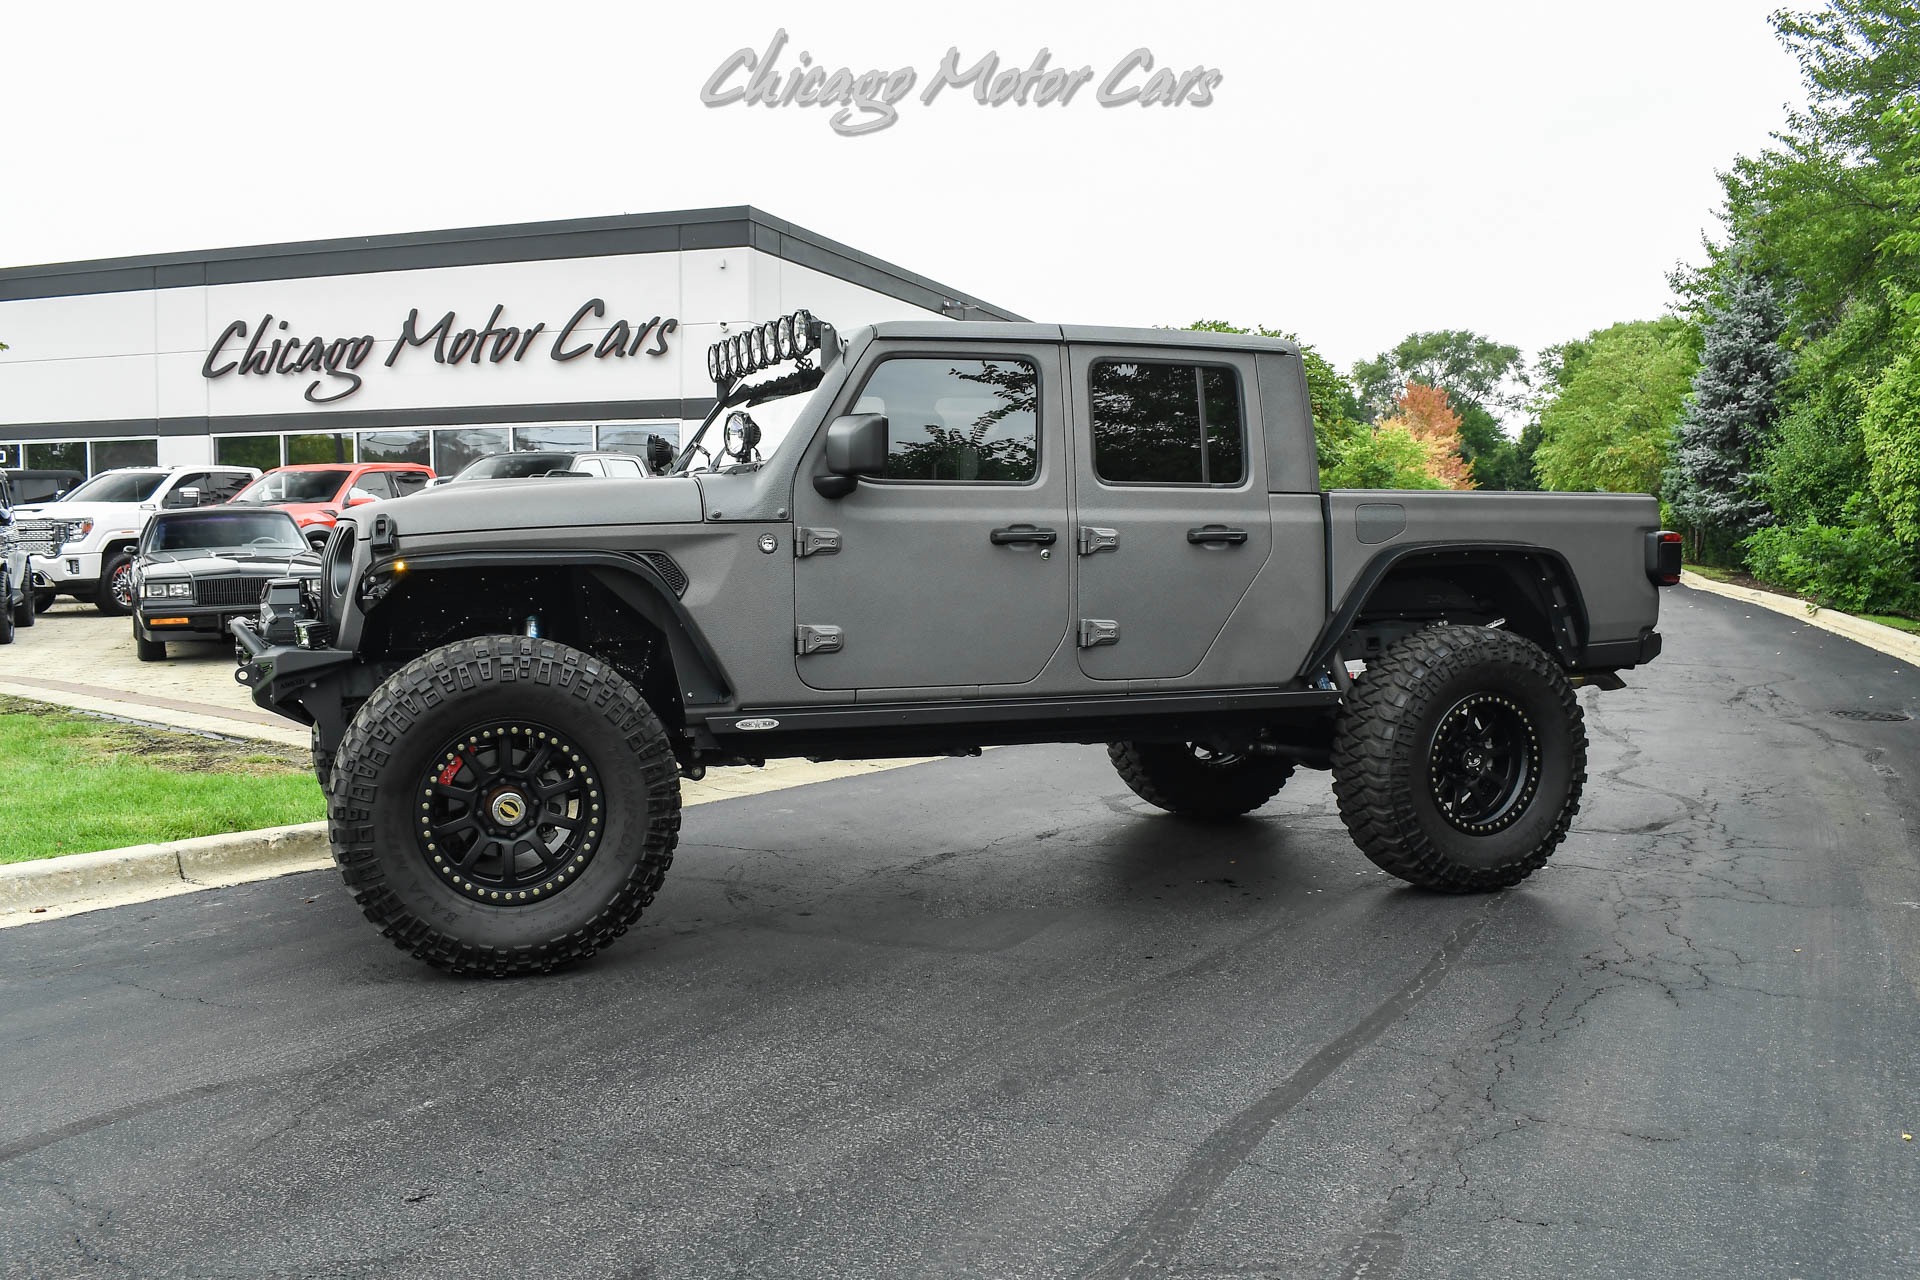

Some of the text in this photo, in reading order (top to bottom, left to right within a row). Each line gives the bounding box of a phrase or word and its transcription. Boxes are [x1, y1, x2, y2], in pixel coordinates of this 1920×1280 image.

[202, 299, 678, 402] Chicago Motor Cars
